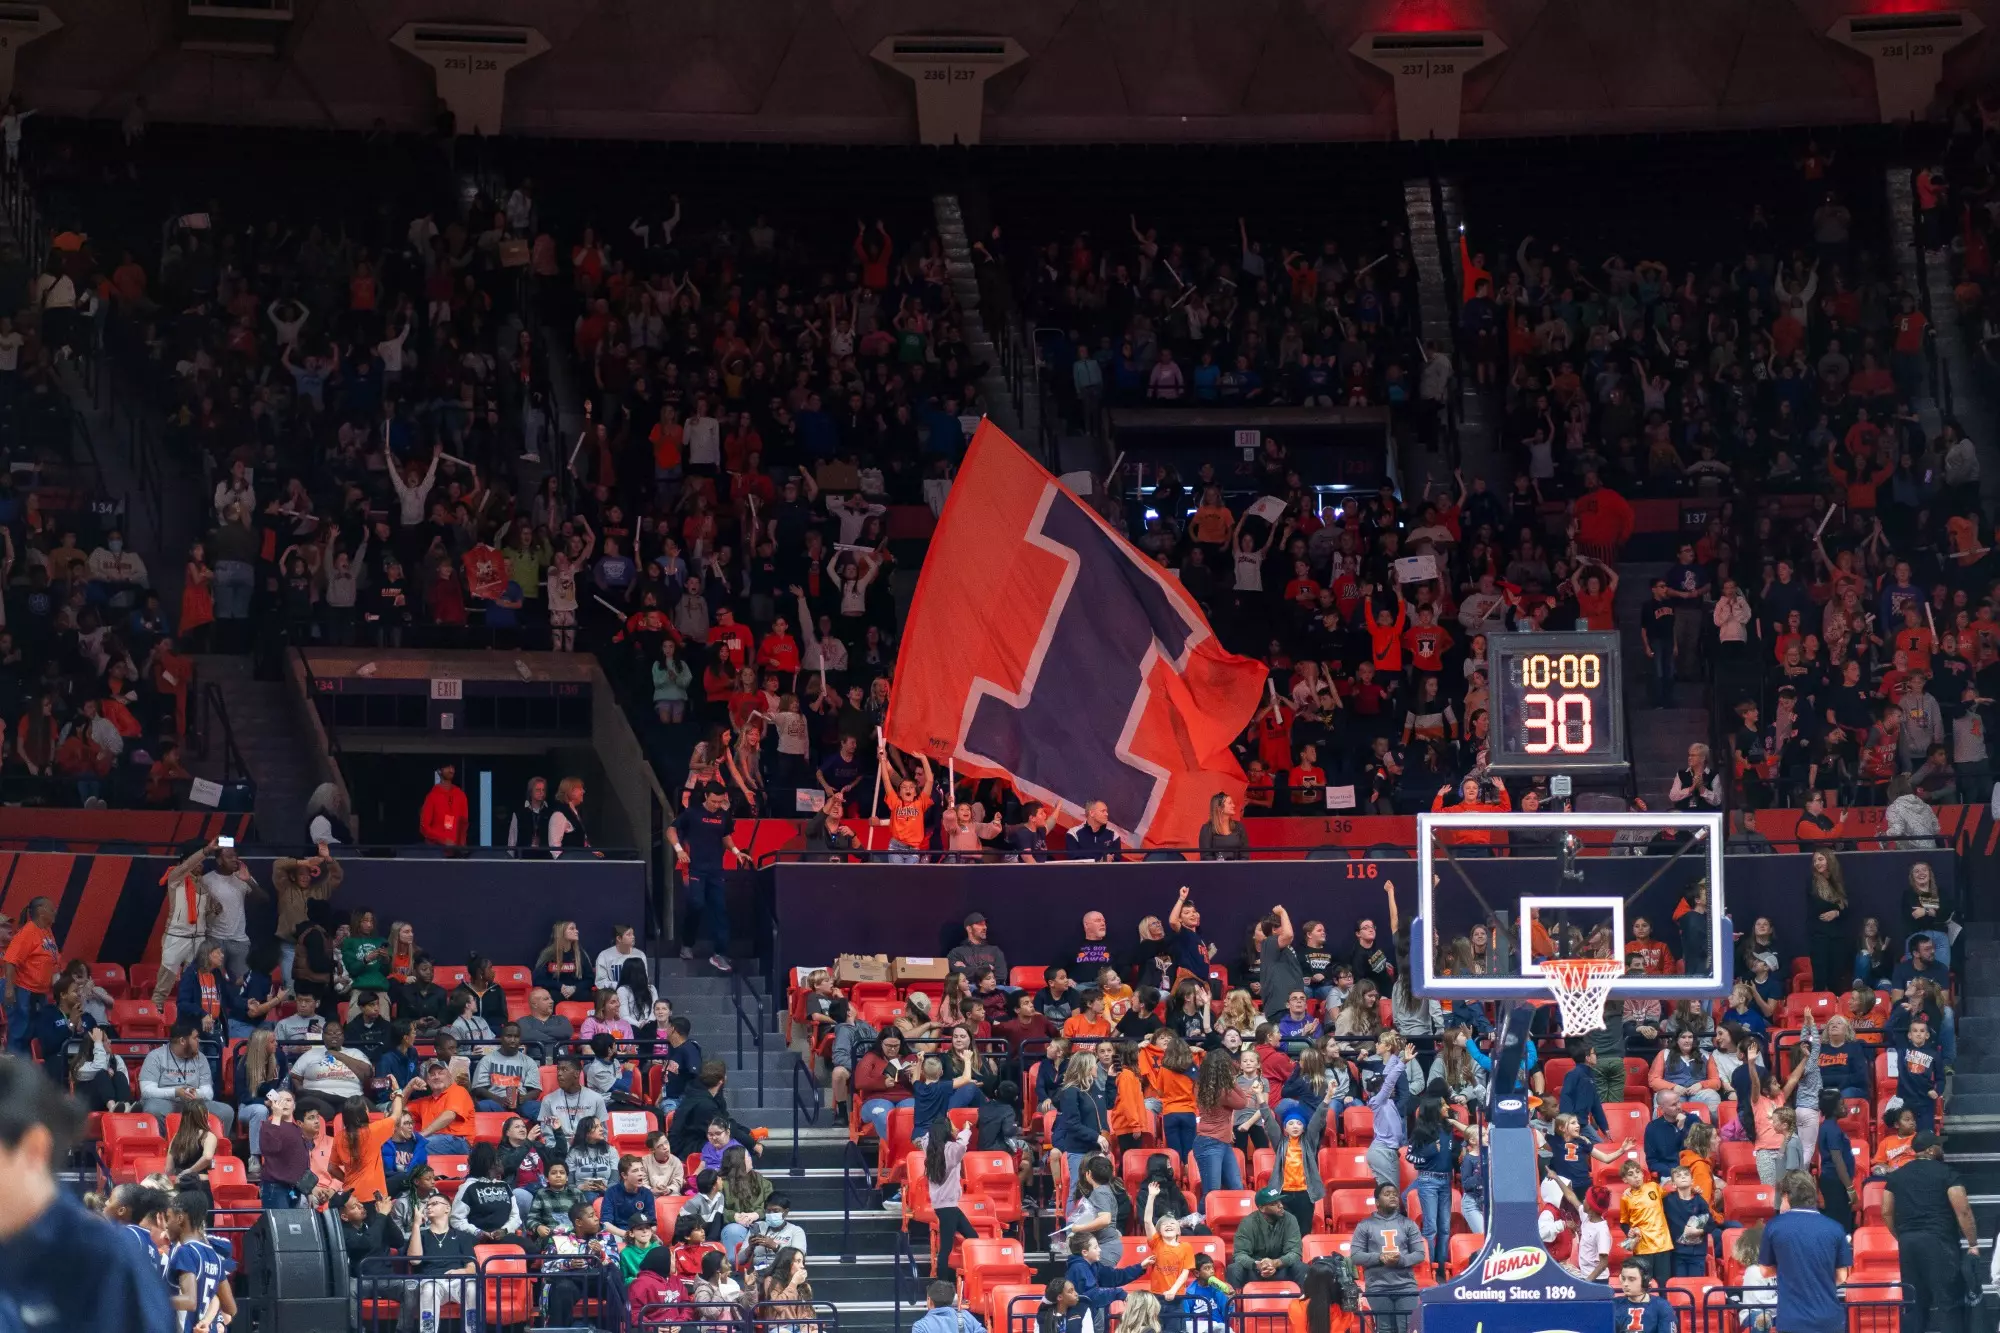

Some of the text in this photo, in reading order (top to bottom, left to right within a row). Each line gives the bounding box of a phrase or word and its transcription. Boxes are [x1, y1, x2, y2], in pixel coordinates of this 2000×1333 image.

[1912, 44, 1934, 55] 239
[475, 59, 497, 71] 236
[1401, 64, 1455, 75] 237 238
[923, 69, 976, 81] 236 237
[1239, 431, 1257, 445] EXIT
[91, 501, 113, 514] 134
[1685, 512, 1707, 524] 137
[1521, 653, 1601, 689] 10:00
[437, 681, 458, 697] EXIT
[1523, 693, 1594, 754] 30
[1858, 809, 1885, 824] 137
[1324, 820, 1353, 833] 136
[1346, 863, 1378, 879] 116
[490, 1063, 523, 1077] ILLINI
[1564, 1142, 1579, 1162] I
[1380, 1229, 1400, 1253] I
[1483, 1252, 1541, 1282] LIBMAN
[196, 1277, 215, 1322] 5
[1454, 1285, 1576, 1302] Cleaning Since 1896
[1626, 1307, 1644, 1331] I
